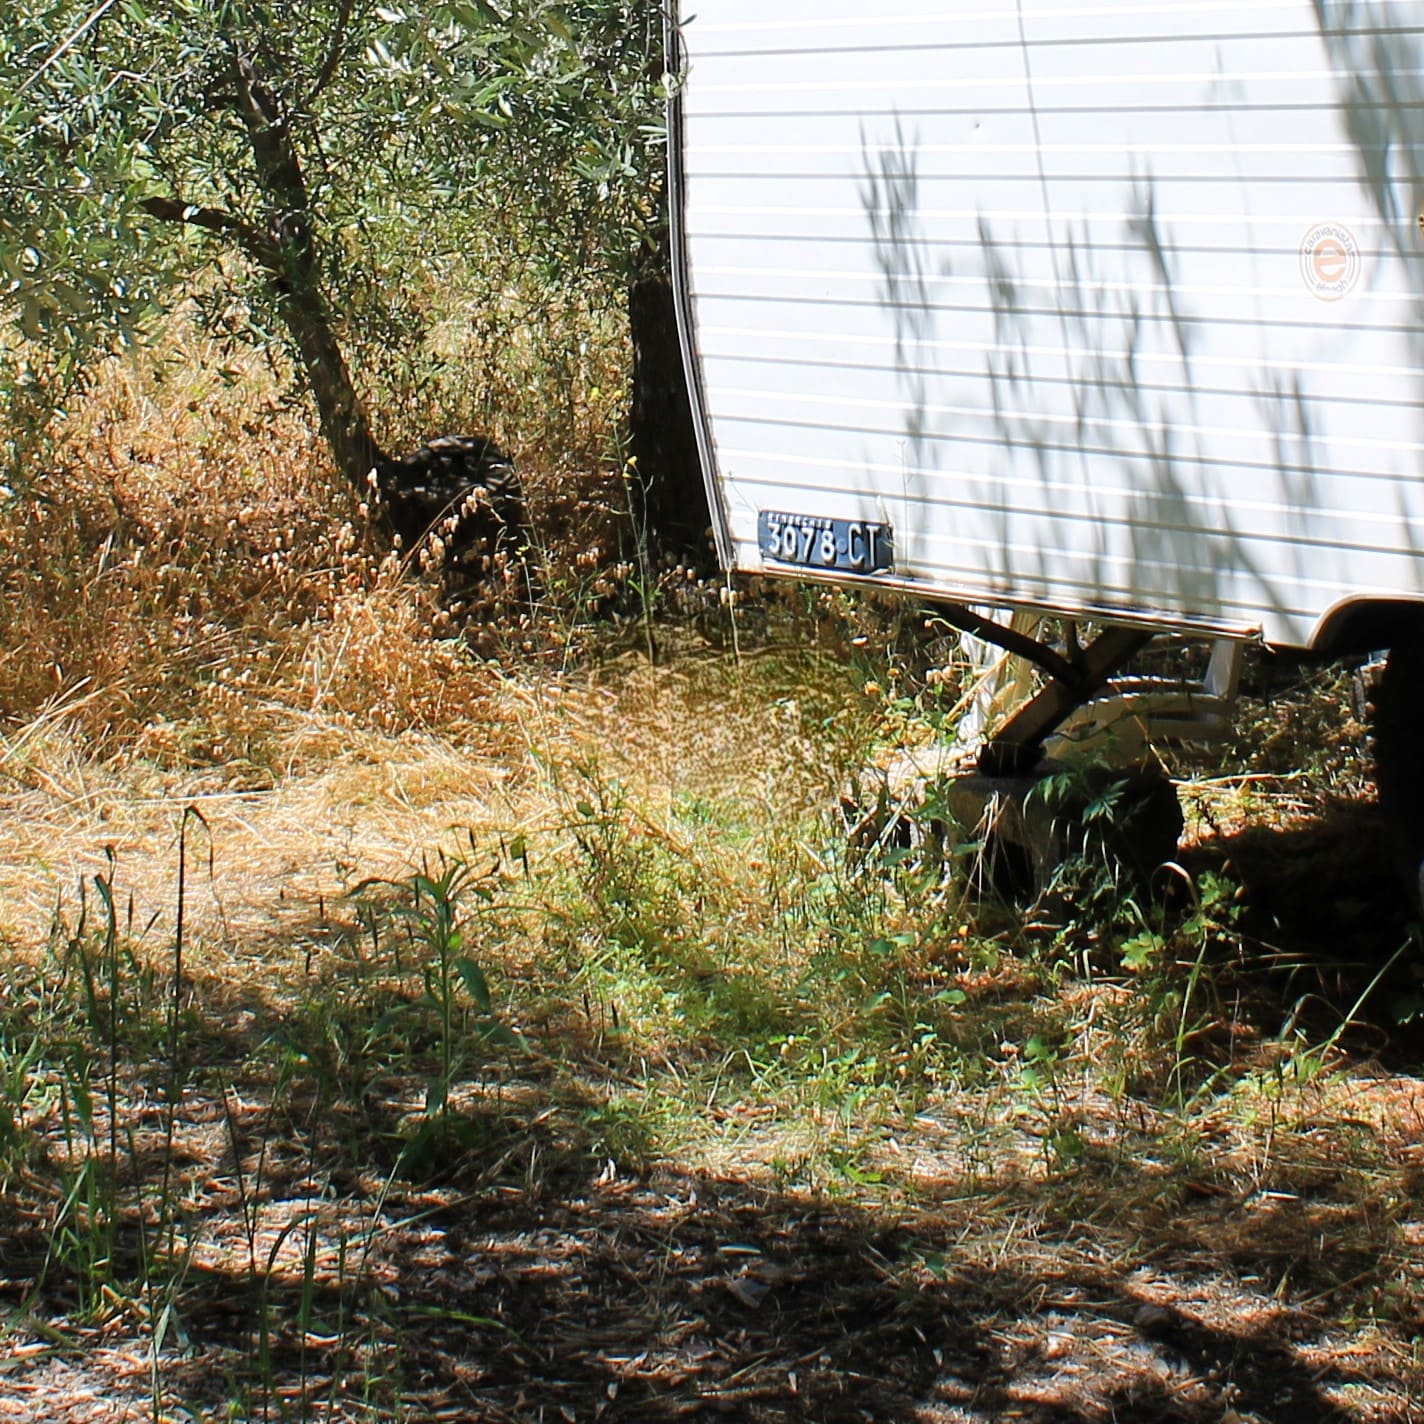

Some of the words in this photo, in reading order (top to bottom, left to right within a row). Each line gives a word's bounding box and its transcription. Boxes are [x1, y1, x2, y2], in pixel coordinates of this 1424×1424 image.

[1304, 225, 1356, 255] caravanista
[767, 512, 832, 529] RIMORCHIO
[767, 522, 836, 564] 3078
[850, 523, 880, 568] CT
